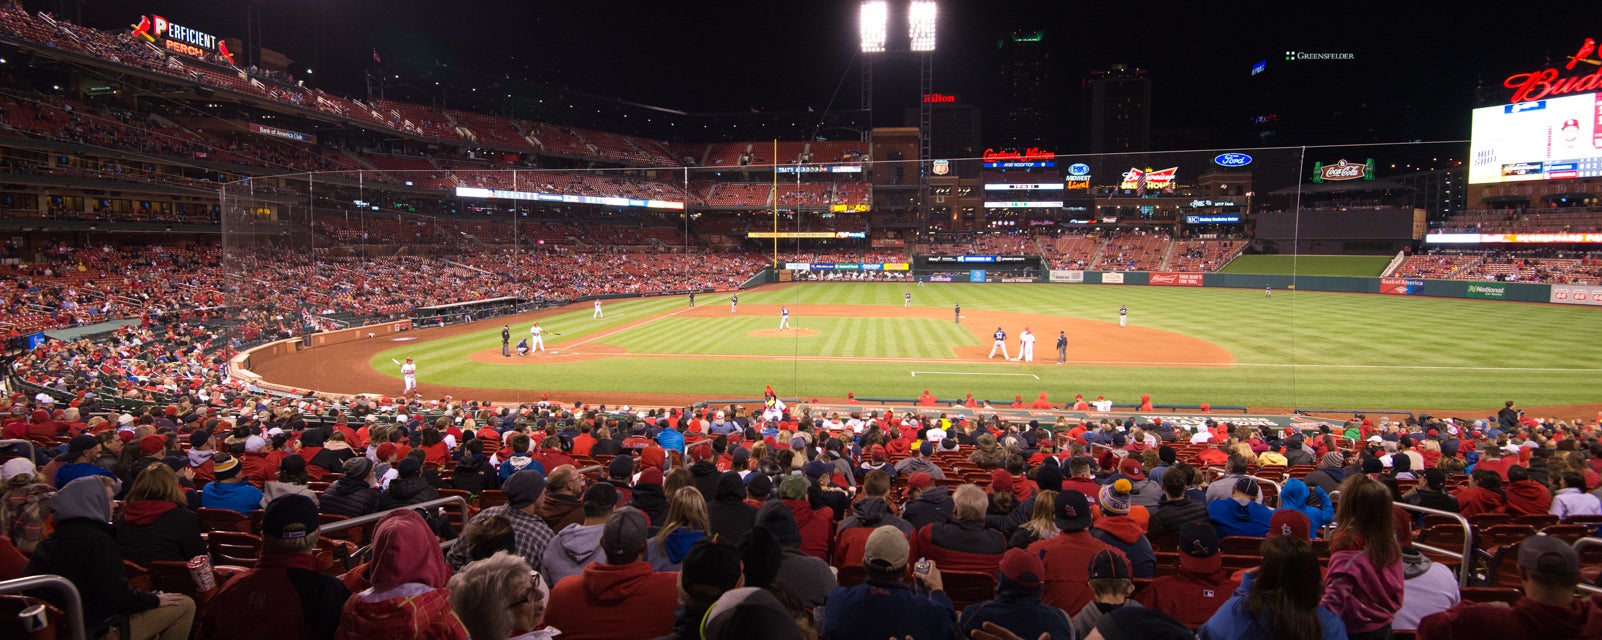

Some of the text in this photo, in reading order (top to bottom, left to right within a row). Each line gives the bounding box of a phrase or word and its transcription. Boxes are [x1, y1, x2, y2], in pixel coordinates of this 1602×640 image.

[153, 14, 216, 49] PERFICIENT
[166, 39, 203, 56] PERCH
[1297, 51, 1354, 60] GREENSFELDER
[923, 93, 955, 103] Hilton
[1222, 153, 1245, 164] Ford
[1072, 165, 1085, 173] FOX
[1122, 171, 1176, 182] Buweiser
[1067, 181, 1089, 190] Live!
[1121, 182, 1176, 190] BRE HOUE
